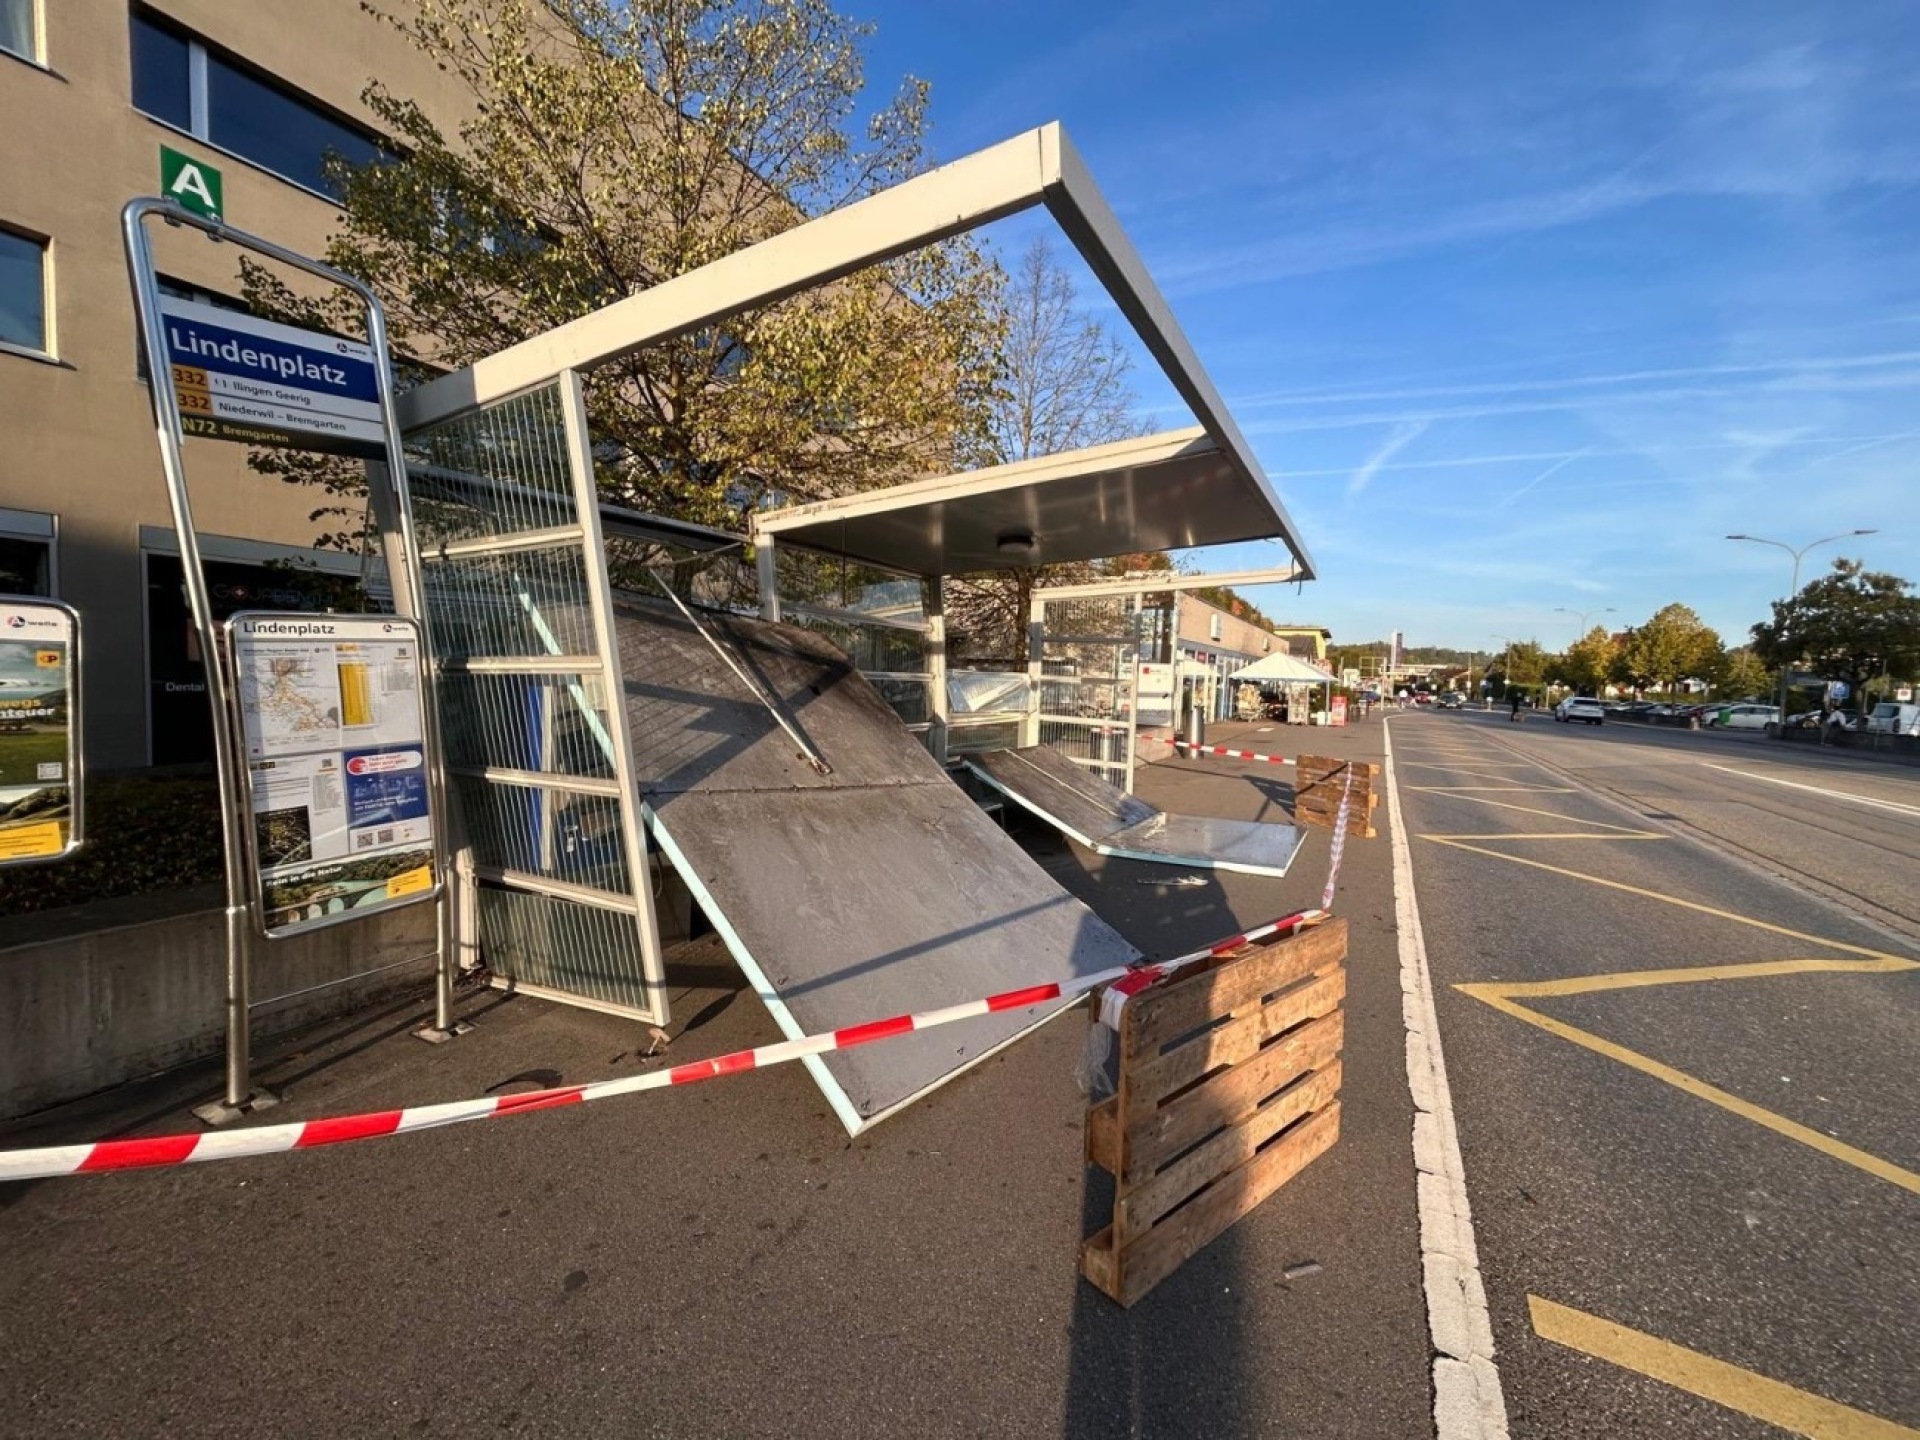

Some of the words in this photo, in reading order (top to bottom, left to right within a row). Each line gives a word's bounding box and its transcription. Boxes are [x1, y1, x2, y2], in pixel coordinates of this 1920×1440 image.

[172, 164, 215, 208] A
[171, 327, 347, 386] Lindenplatz
[173, 368, 207, 387] 332
[178, 394, 210, 411] 332
[219, 402, 274, 419] Niederwil
[286, 413, 346, 432] Bremgarten
[183, 417, 217, 434] N72
[222, 425, 289, 443] Bremgarten
[243, 622, 335, 636] Lindenplatz
[166, 681, 205, 692] Dental
[290, 875, 301, 883] in
[301, 871, 317, 881] die
